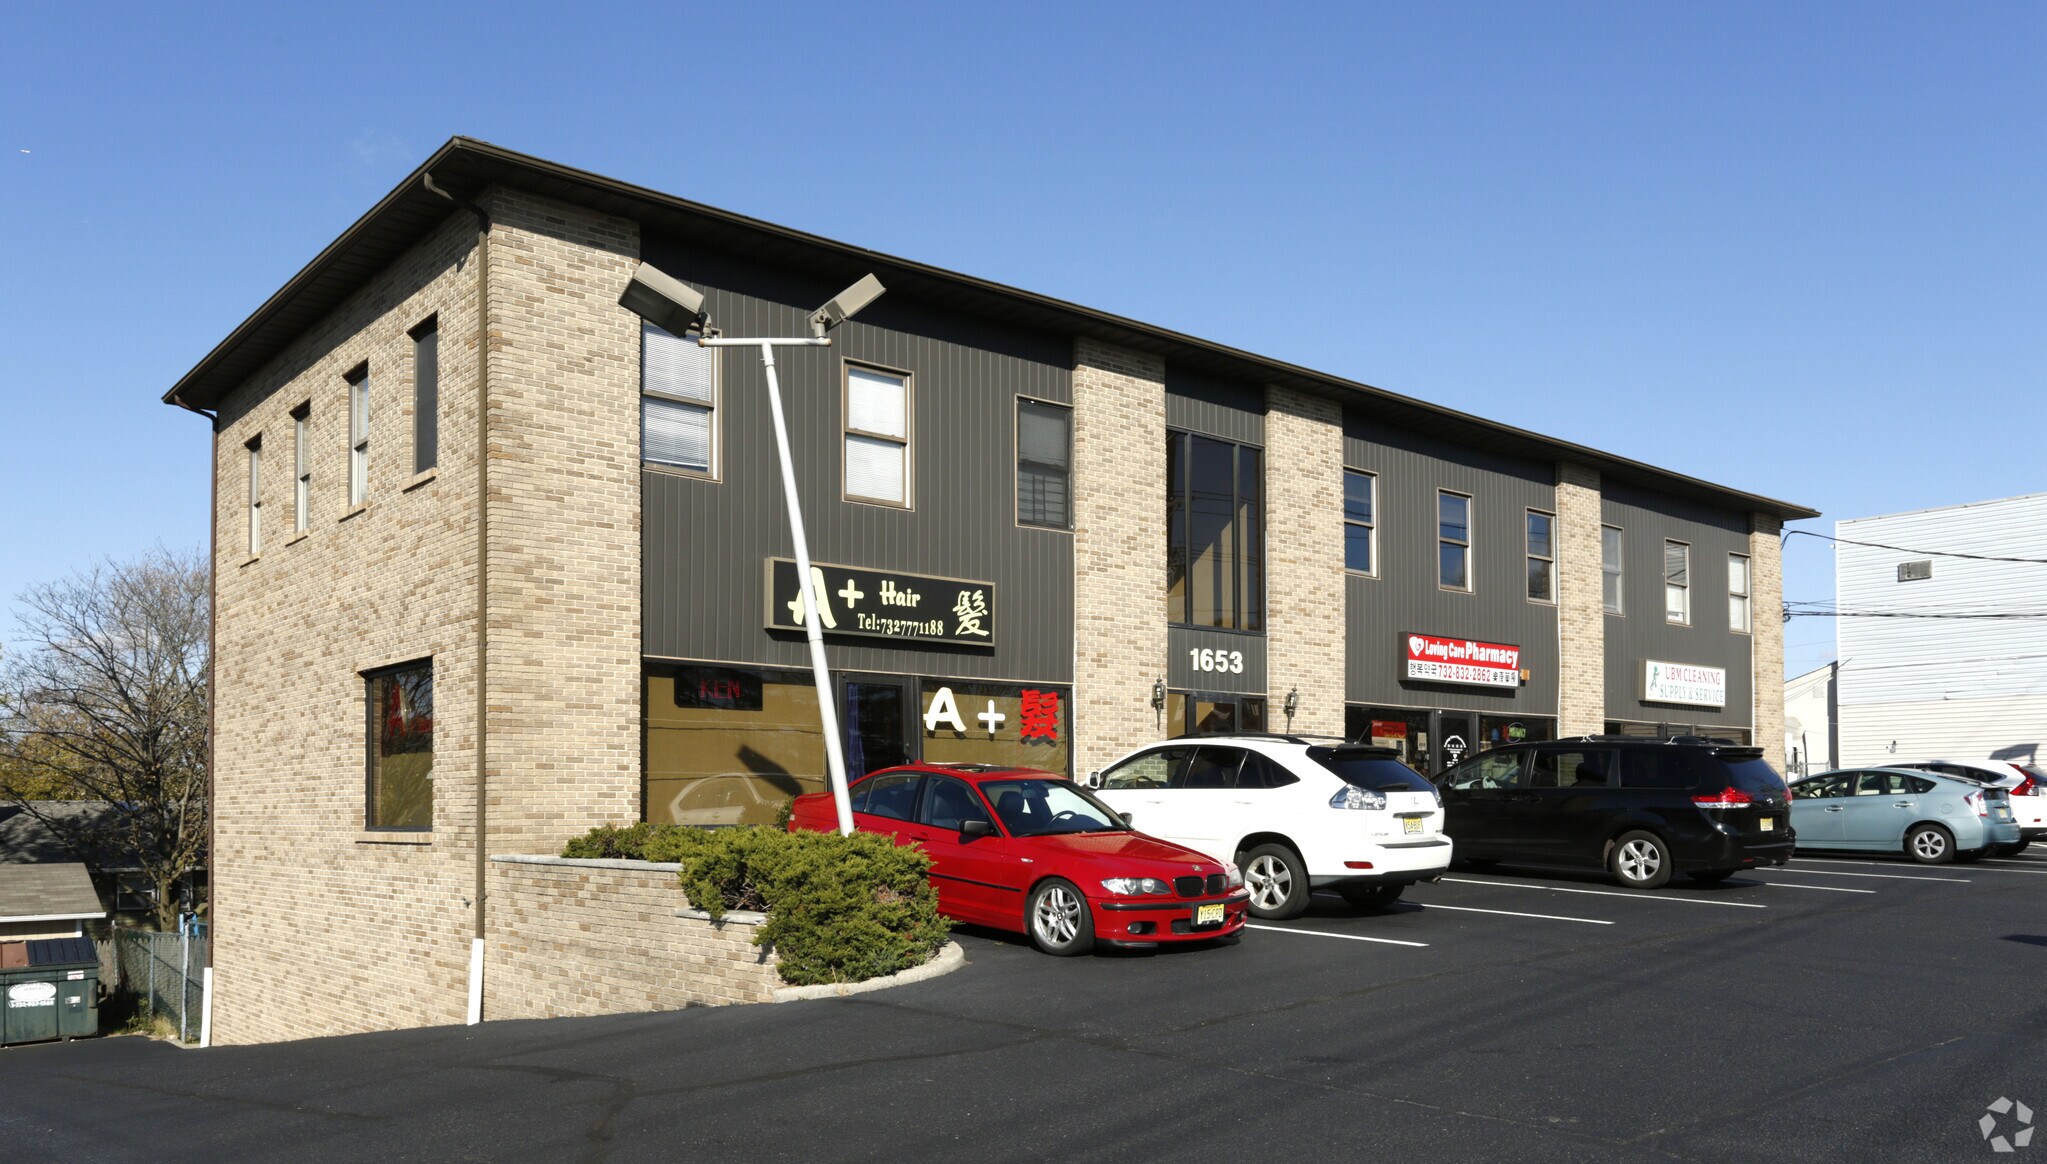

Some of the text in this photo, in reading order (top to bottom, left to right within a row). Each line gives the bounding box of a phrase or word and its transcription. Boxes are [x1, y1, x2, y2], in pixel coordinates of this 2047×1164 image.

[879, 580, 921, 607] Hair
[858, 612, 944, 637] Tel:7327771188
[1190, 648, 1244, 674] 1653
[1425, 640, 1519, 669] Loving Care Pharmacy
[1438, 664, 1491, 682] 732-832-2862
[1665, 666, 1721, 685] UBM CLEANING
[1660, 684, 1724, 703] SUPPLY & SERVICE
